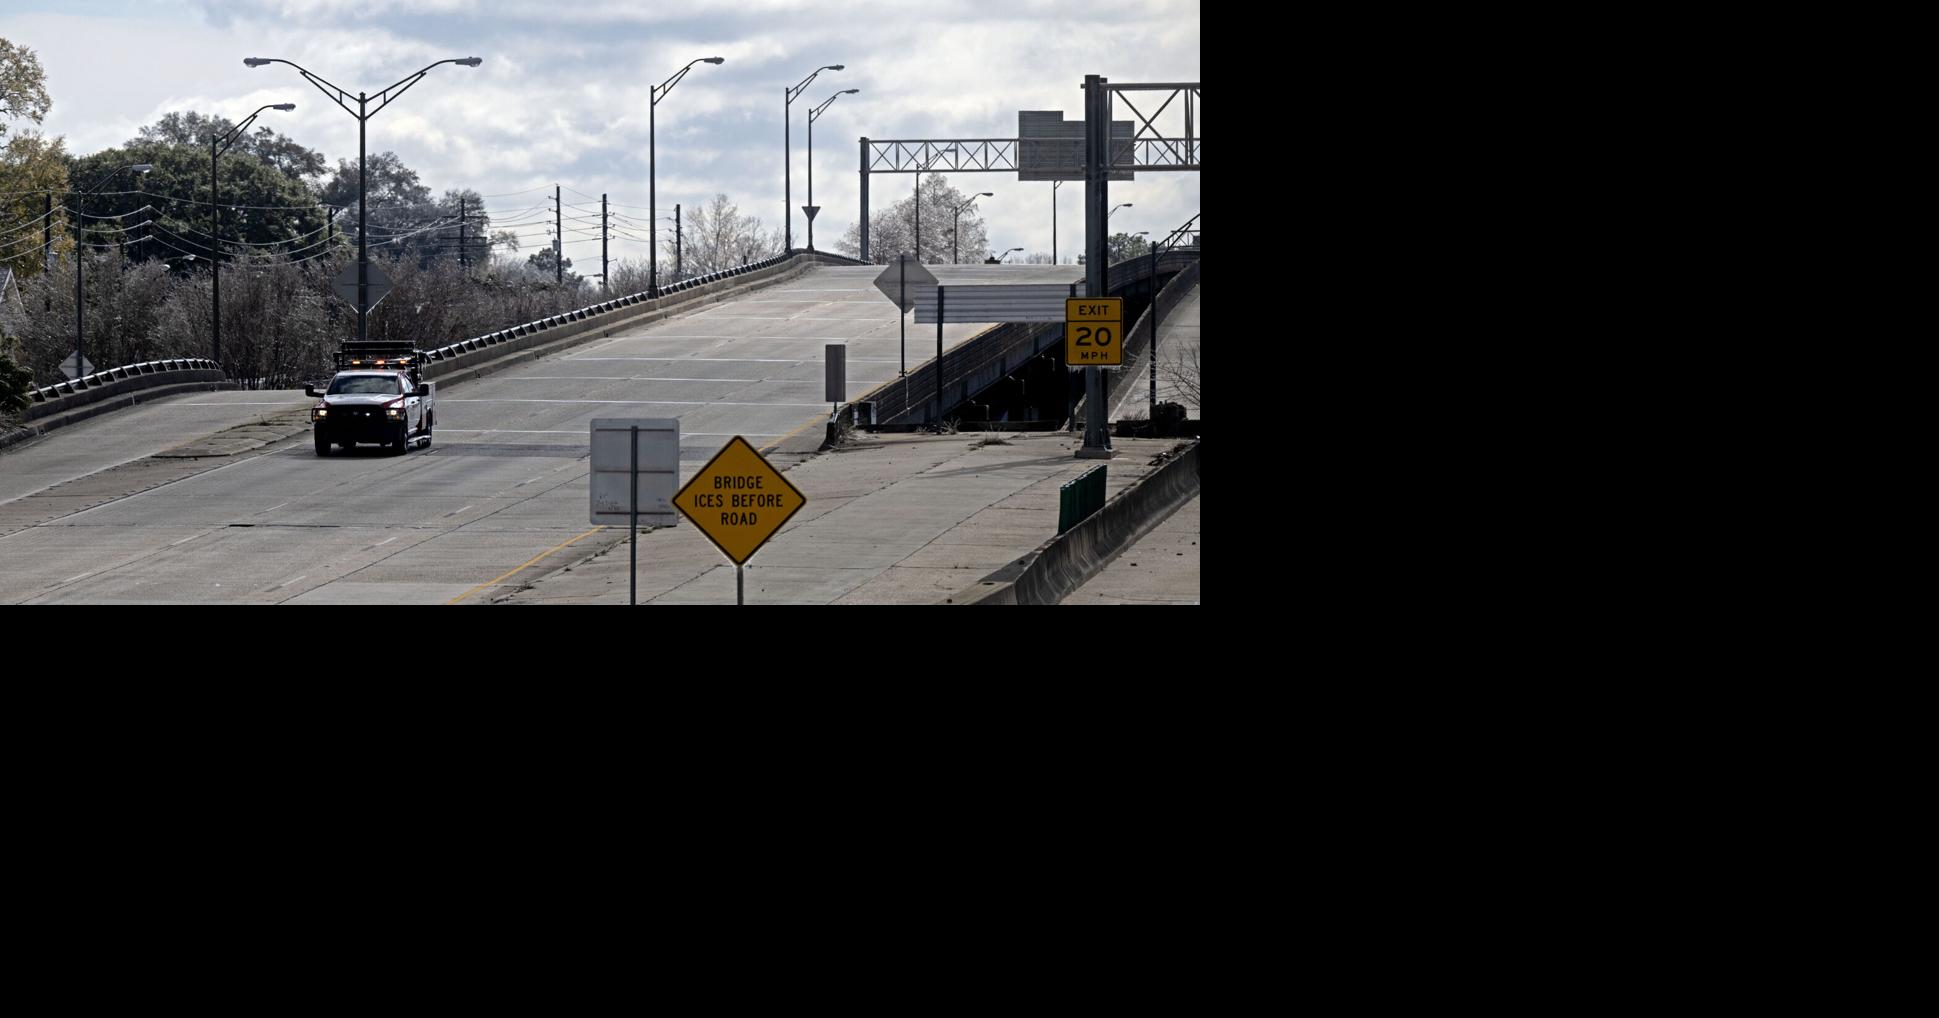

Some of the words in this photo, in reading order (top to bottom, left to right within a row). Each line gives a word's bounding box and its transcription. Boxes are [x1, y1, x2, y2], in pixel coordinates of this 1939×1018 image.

[1078, 305, 1109, 316] EXIT
[1076, 326, 1112, 347] 20
[1080, 351, 1108, 360] MPH
[714, 476, 763, 489] BRIDGE
[694, 494, 723, 508] ICES
[732, 494, 783, 507] BEFORE
[721, 512, 757, 525] ROAD
